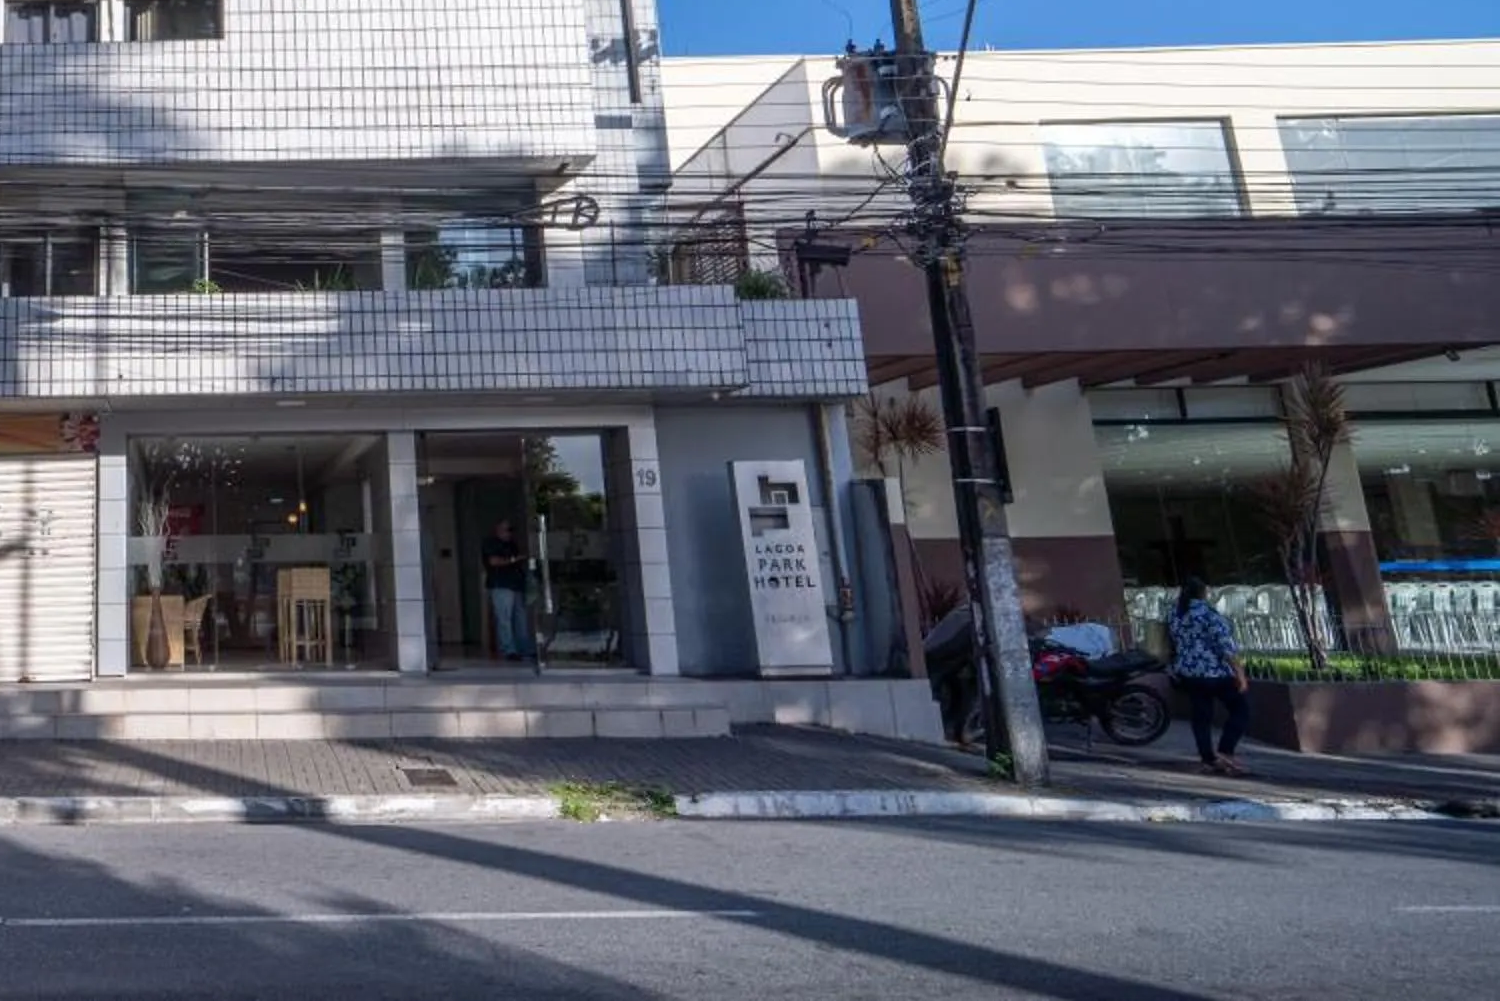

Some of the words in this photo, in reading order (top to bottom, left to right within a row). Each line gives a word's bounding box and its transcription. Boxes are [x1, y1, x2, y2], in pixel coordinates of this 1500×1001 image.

[636, 468, 656, 487] 19
[755, 543, 805, 554] LAGOA
[758, 558, 807, 572] PARK
[754, 575, 817, 591] HOTEL
